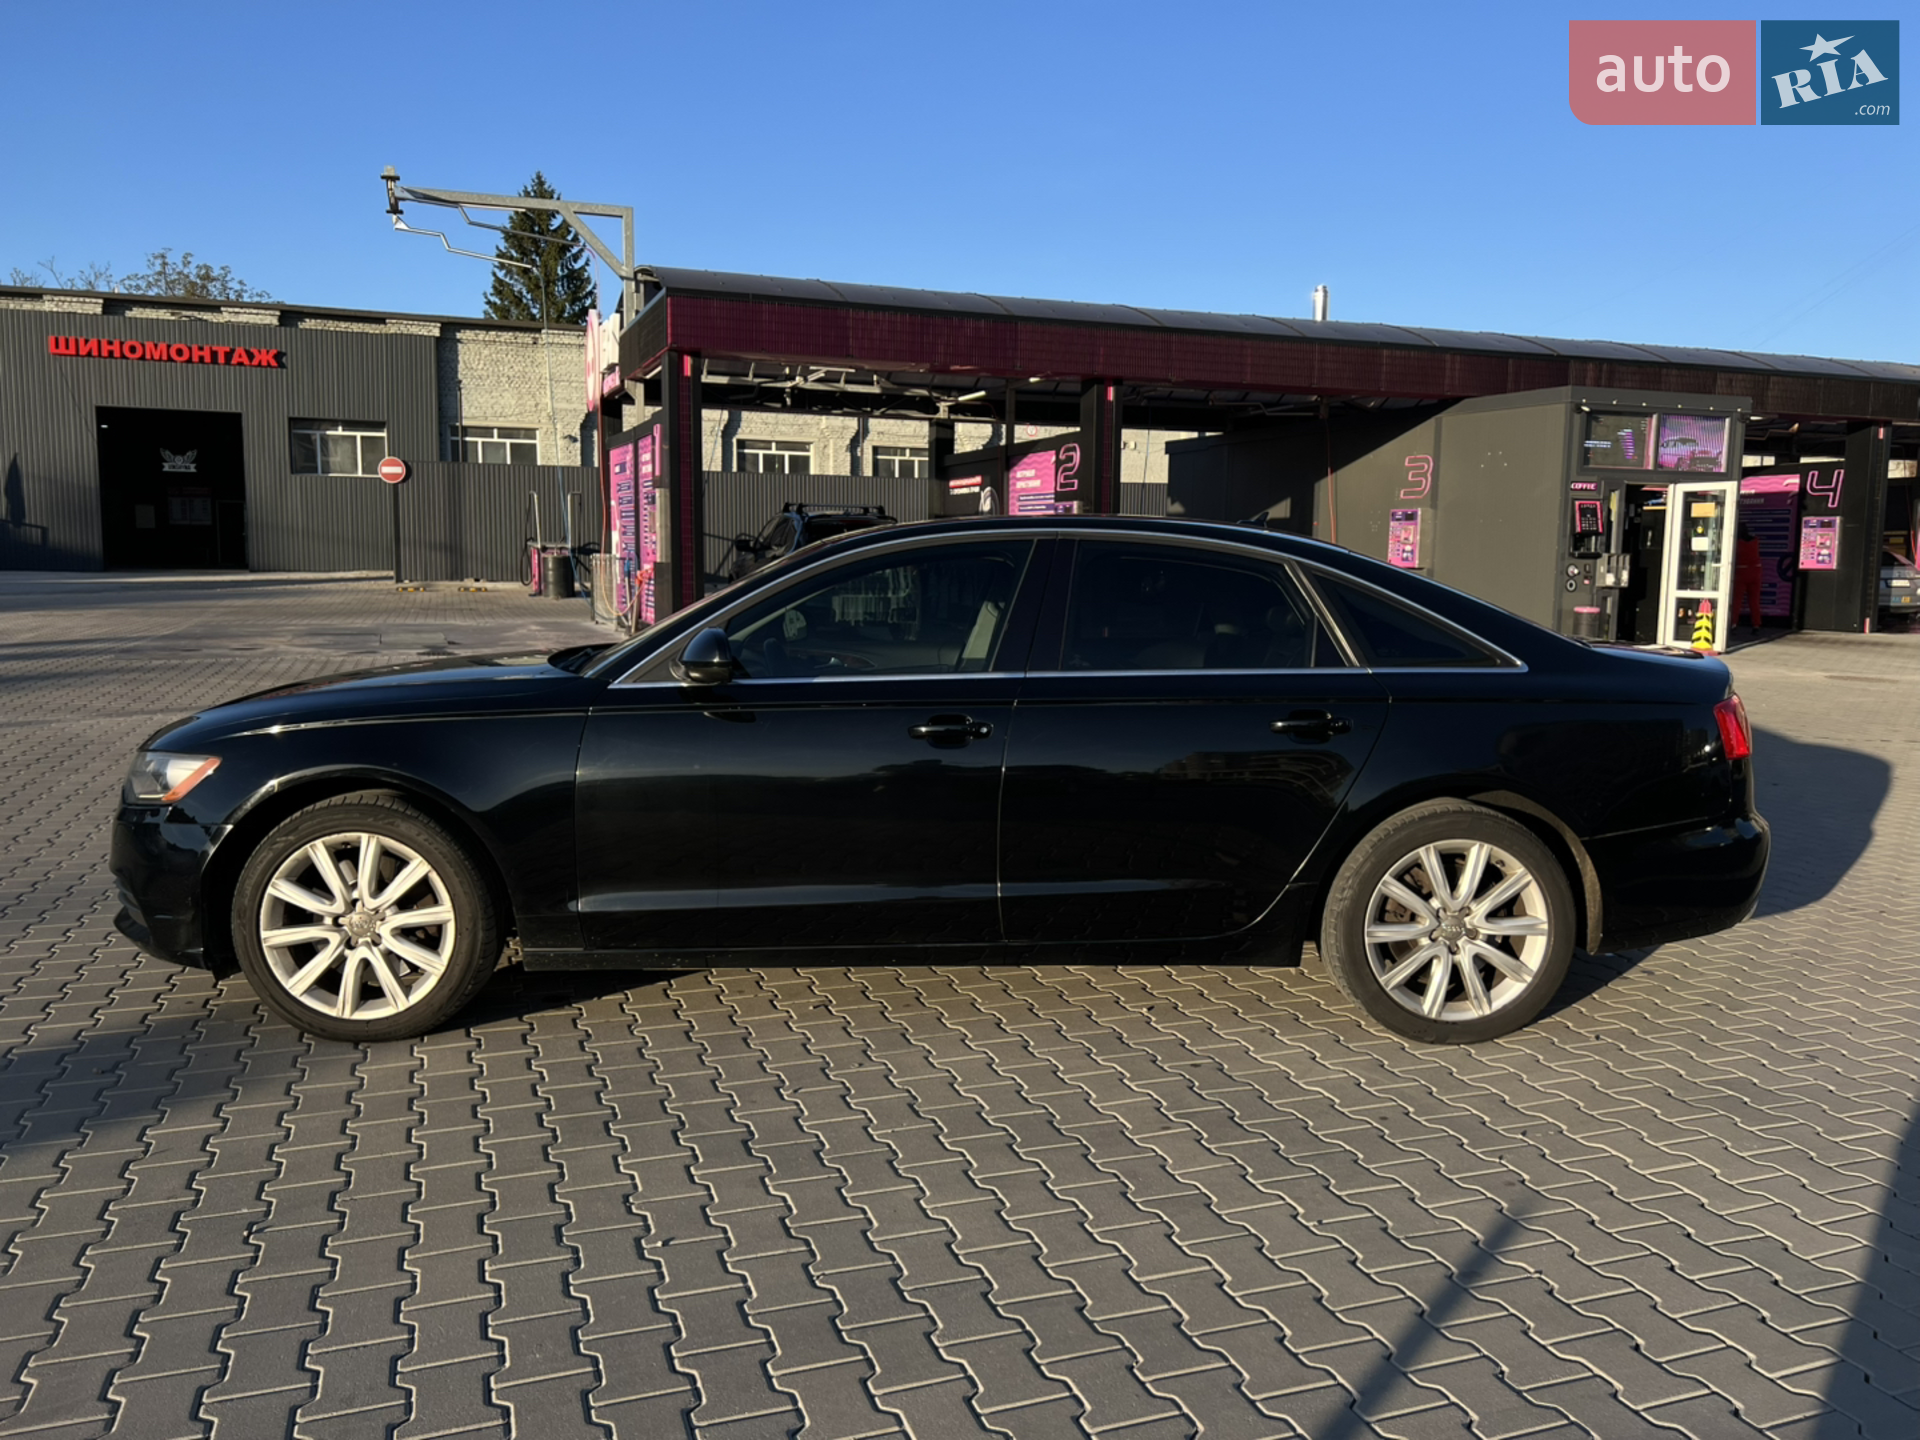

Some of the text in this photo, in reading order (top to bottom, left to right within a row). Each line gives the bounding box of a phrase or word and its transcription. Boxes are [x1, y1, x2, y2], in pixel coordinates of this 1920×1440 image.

[48, 335, 279, 367] ШИНОМОНТАЖ
[1056, 443, 1081, 491] 2
[1400, 454, 1434, 499] 3
[1806, 469, 1845, 508] 4
